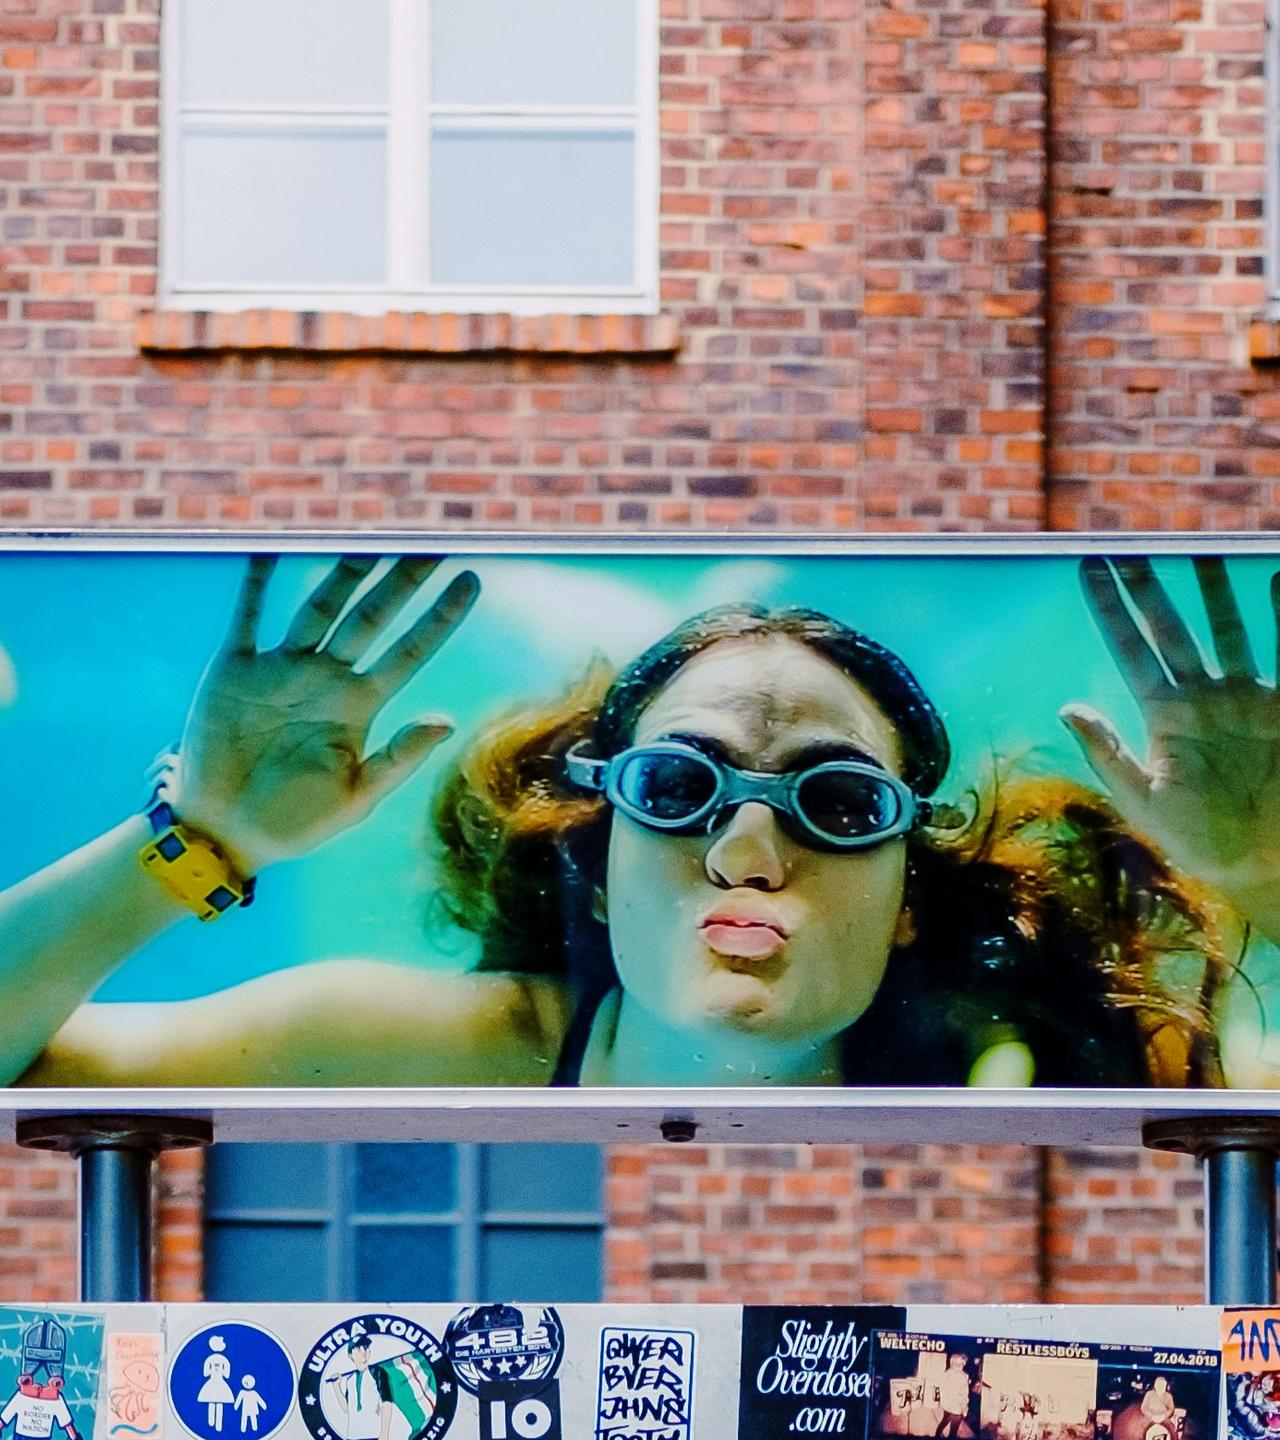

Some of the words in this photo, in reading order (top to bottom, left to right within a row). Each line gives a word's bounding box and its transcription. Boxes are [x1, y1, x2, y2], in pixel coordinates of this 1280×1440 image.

[375, 1318, 442, 1363] YOUTH
[776, 1320, 868, 1366] Slightly
[880, 1338, 945, 1352] WELTECHO
[997, 1343, 1089, 1359] RESTLESSBOYS
[1154, 1353, 1218, 1367] 27.04.2018
[489, 1399, 552, 1440] 10
[789, 1404, 846, 1434] .com
